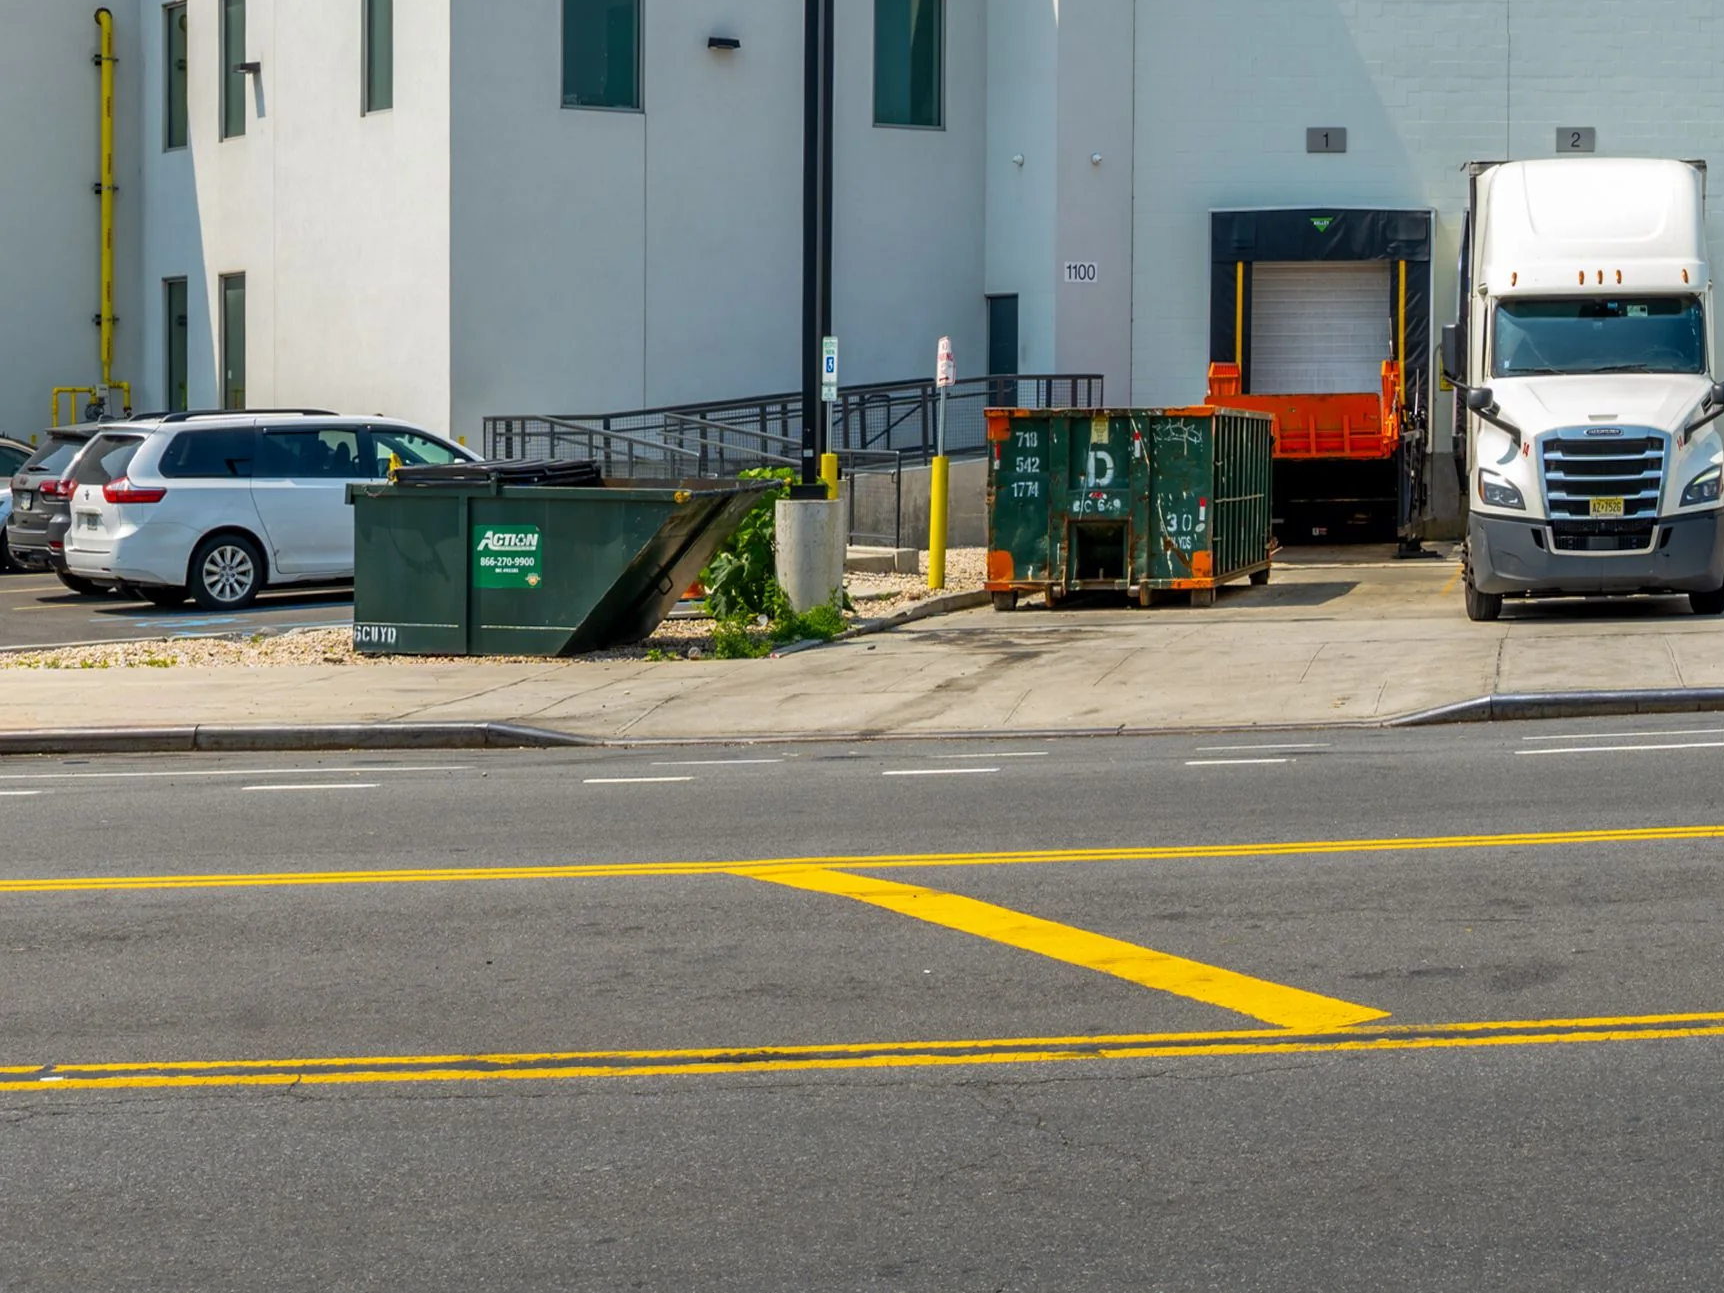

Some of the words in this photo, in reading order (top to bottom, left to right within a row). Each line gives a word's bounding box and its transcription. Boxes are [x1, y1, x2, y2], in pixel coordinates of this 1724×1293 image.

[1322, 132, 1329, 148] 1
[1570, 131, 1581, 148] 2
[1066, 263, 1096, 280] 1100
[1015, 431, 1038, 448] 718
[1015, 457, 1040, 473] 542
[1086, 450, 1114, 488] D
[1011, 482, 1039, 498] 1774
[476, 530, 540, 552] ACTION
[480, 556, 535, 567] 866-270-9900
